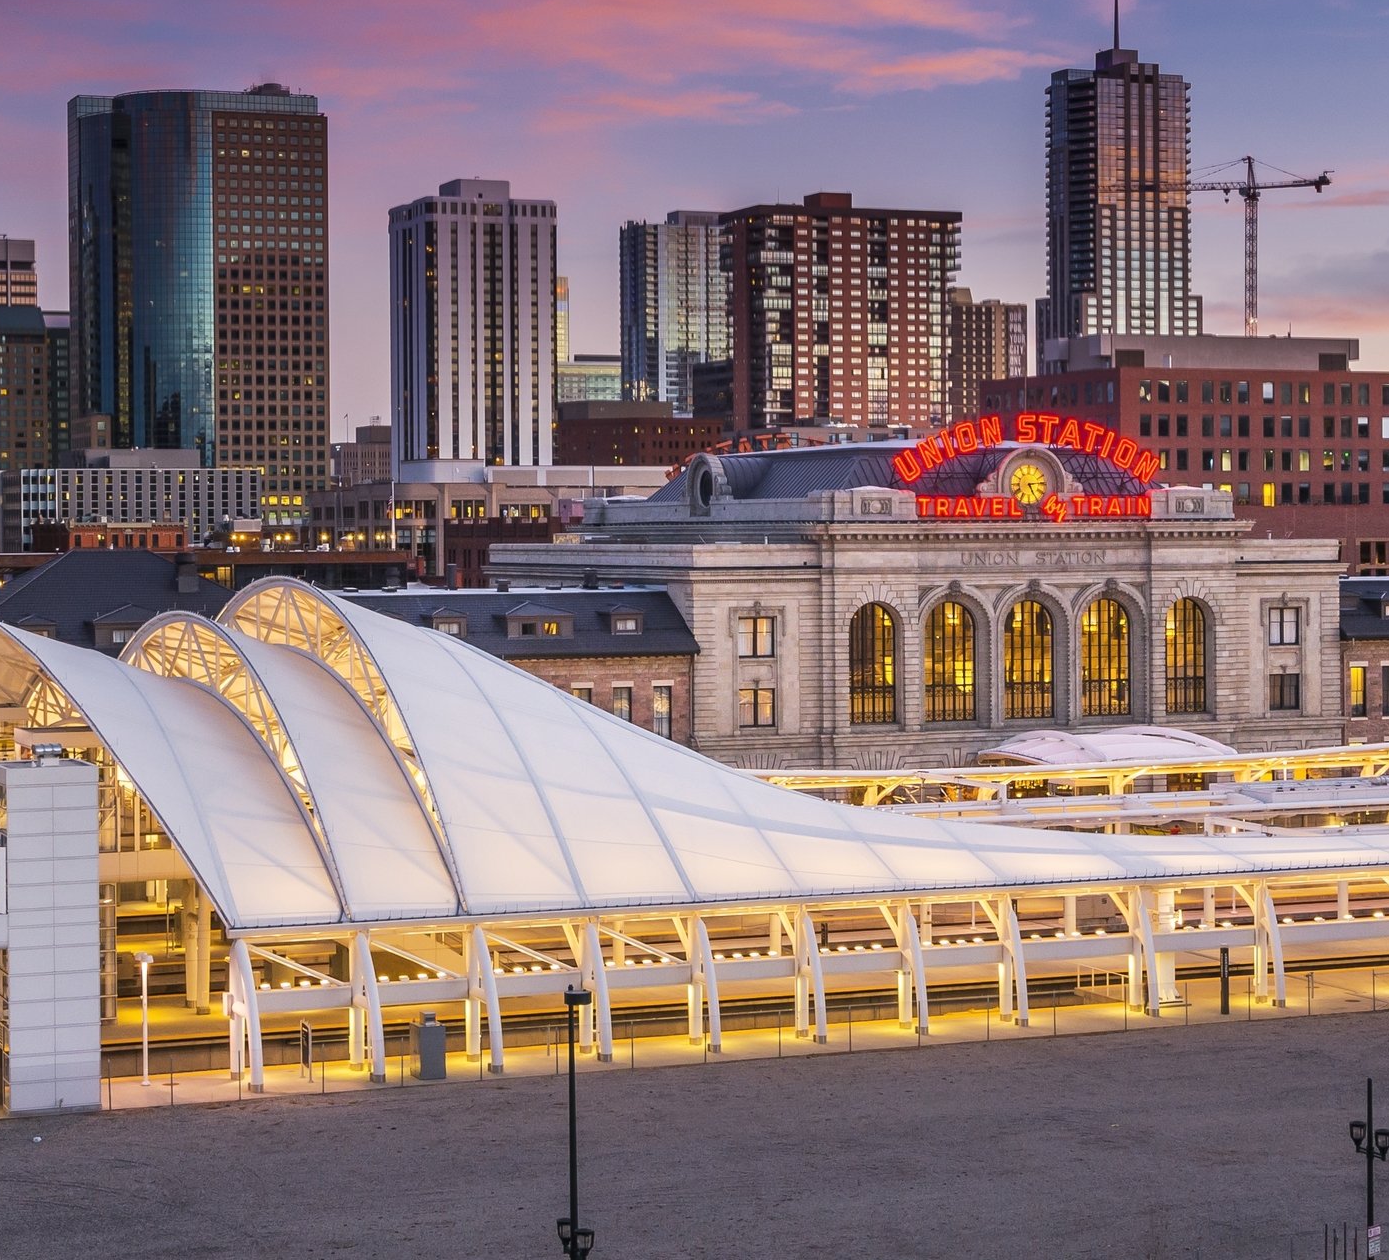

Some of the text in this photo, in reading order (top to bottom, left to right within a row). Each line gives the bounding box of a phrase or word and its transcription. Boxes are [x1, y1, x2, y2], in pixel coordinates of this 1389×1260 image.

[894, 414, 1160, 484] UNION STATION
[918, 495, 1151, 522] TRAVEL by TRAIN
[961, 550, 1107, 566] UNION STATION
